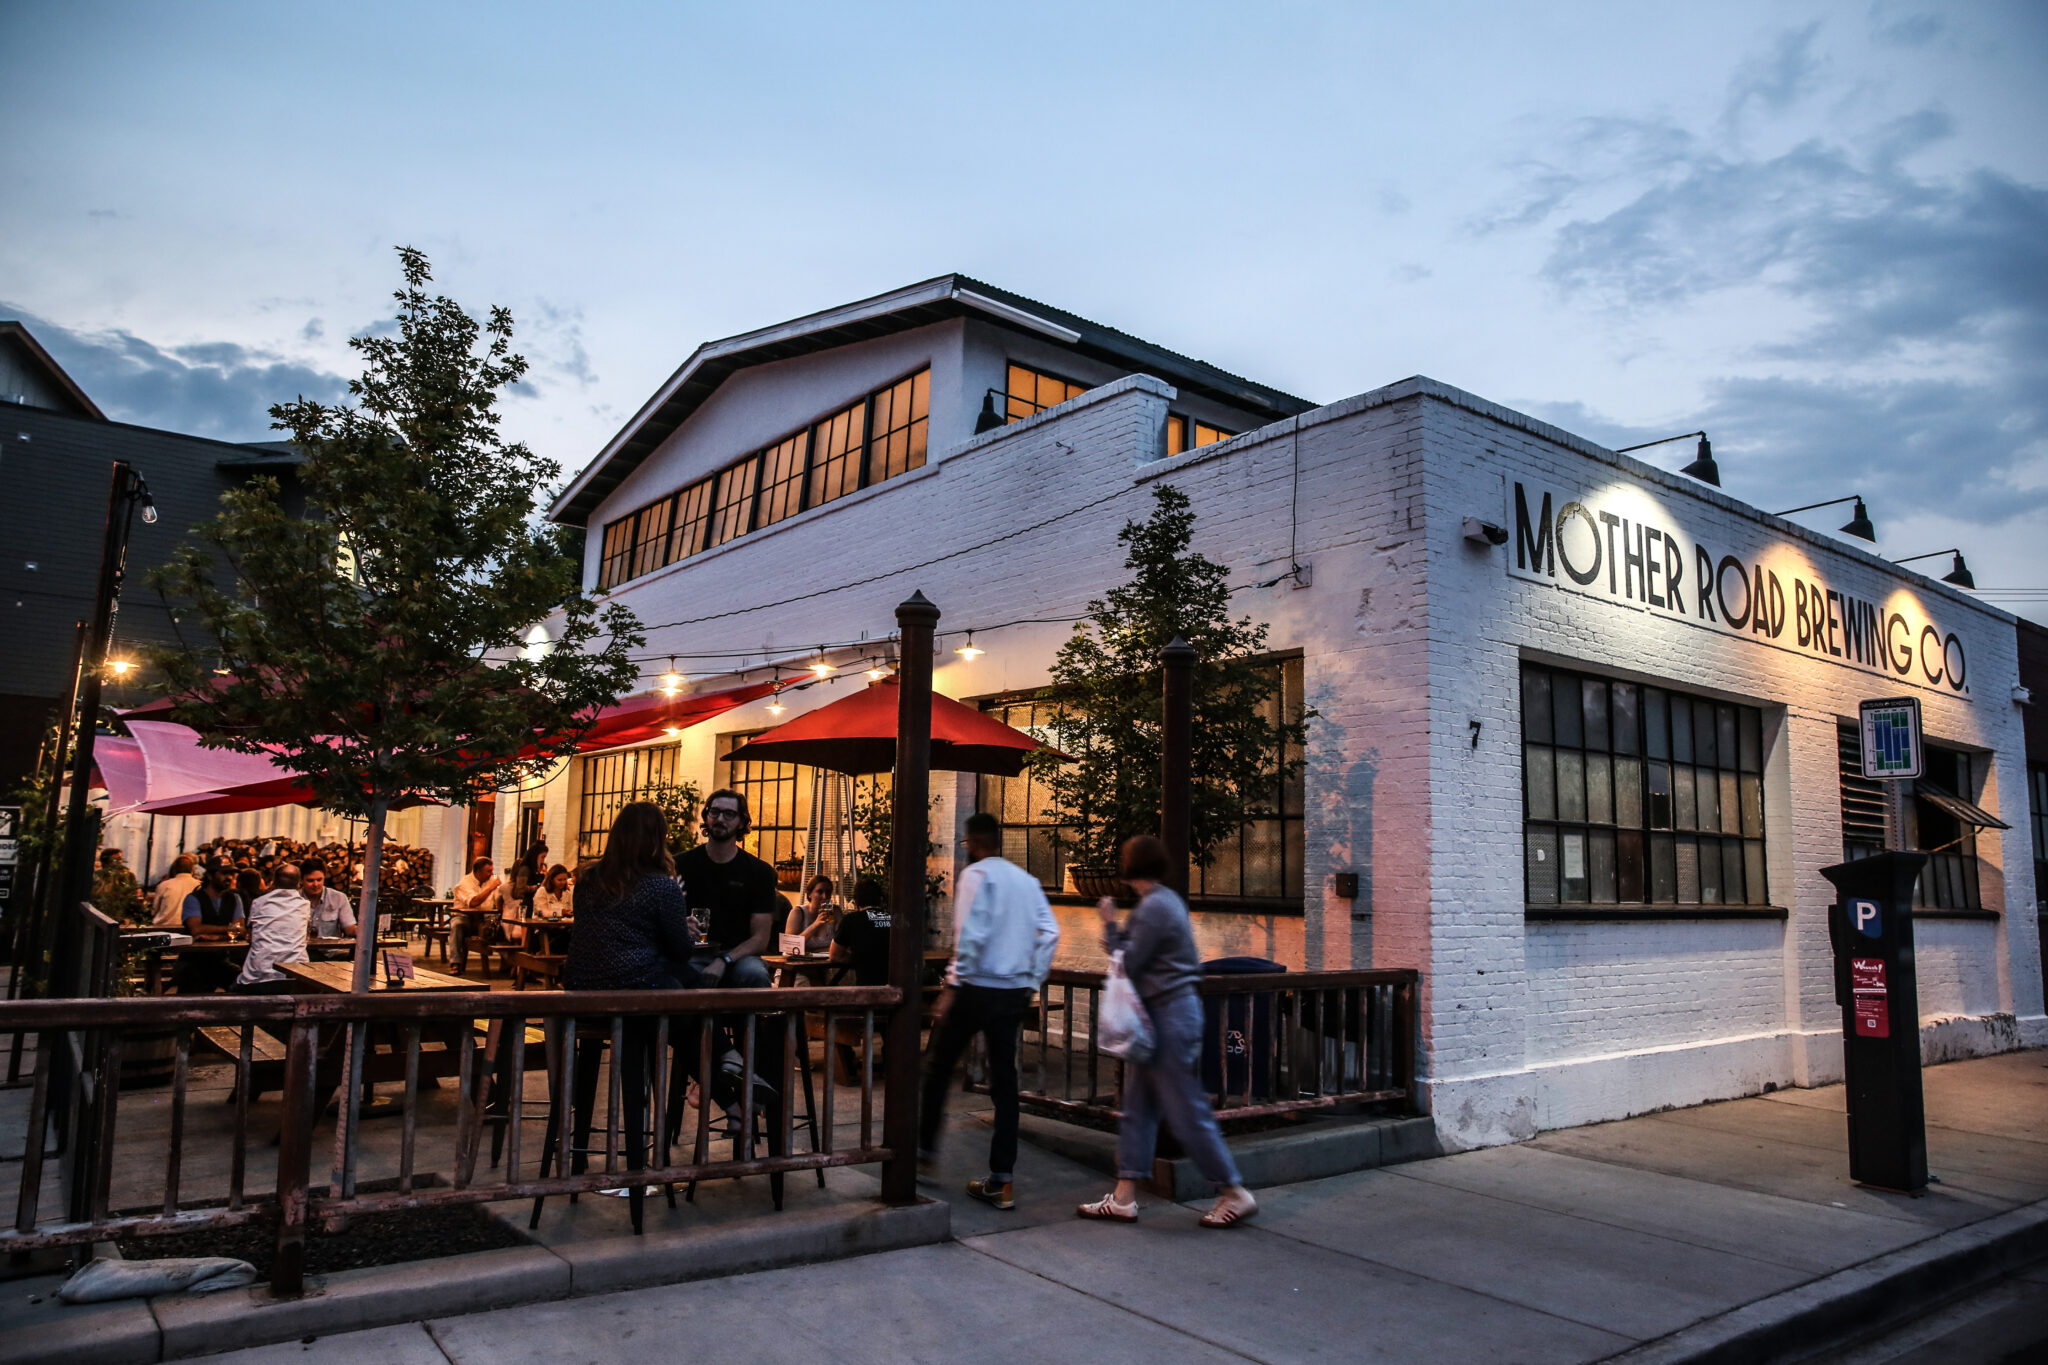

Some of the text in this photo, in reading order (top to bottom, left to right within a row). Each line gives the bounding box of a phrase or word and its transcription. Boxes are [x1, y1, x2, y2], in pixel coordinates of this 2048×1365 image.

[1514, 481, 1969, 694] MOTHER ROAD BREWING CO.
[1856, 902, 1876, 930] P
